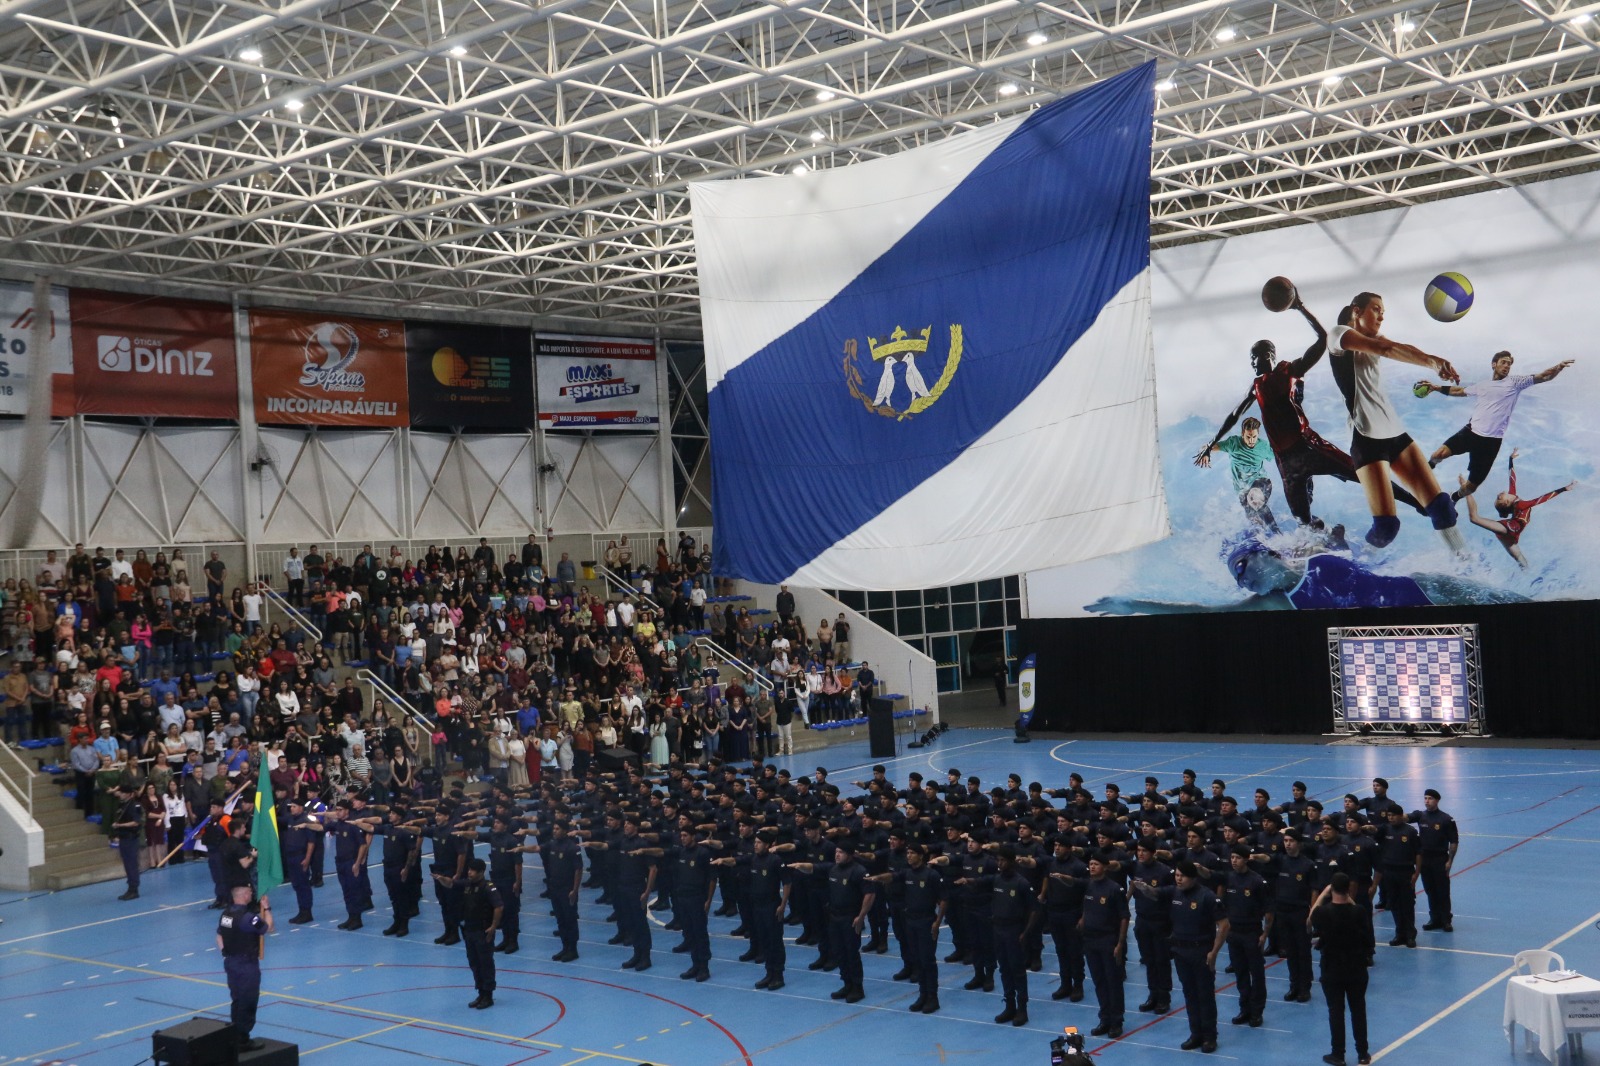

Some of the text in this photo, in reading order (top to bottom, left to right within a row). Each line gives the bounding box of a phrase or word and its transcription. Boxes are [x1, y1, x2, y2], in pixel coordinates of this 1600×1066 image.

[134, 337, 162, 346] ÓTICAS
[135, 347, 214, 377] DINIZ
[487, 379, 511, 388] solar
[565, 383, 634, 399] ESPORTES
[267, 397, 397, 416] INCOMPARÁVEL!
